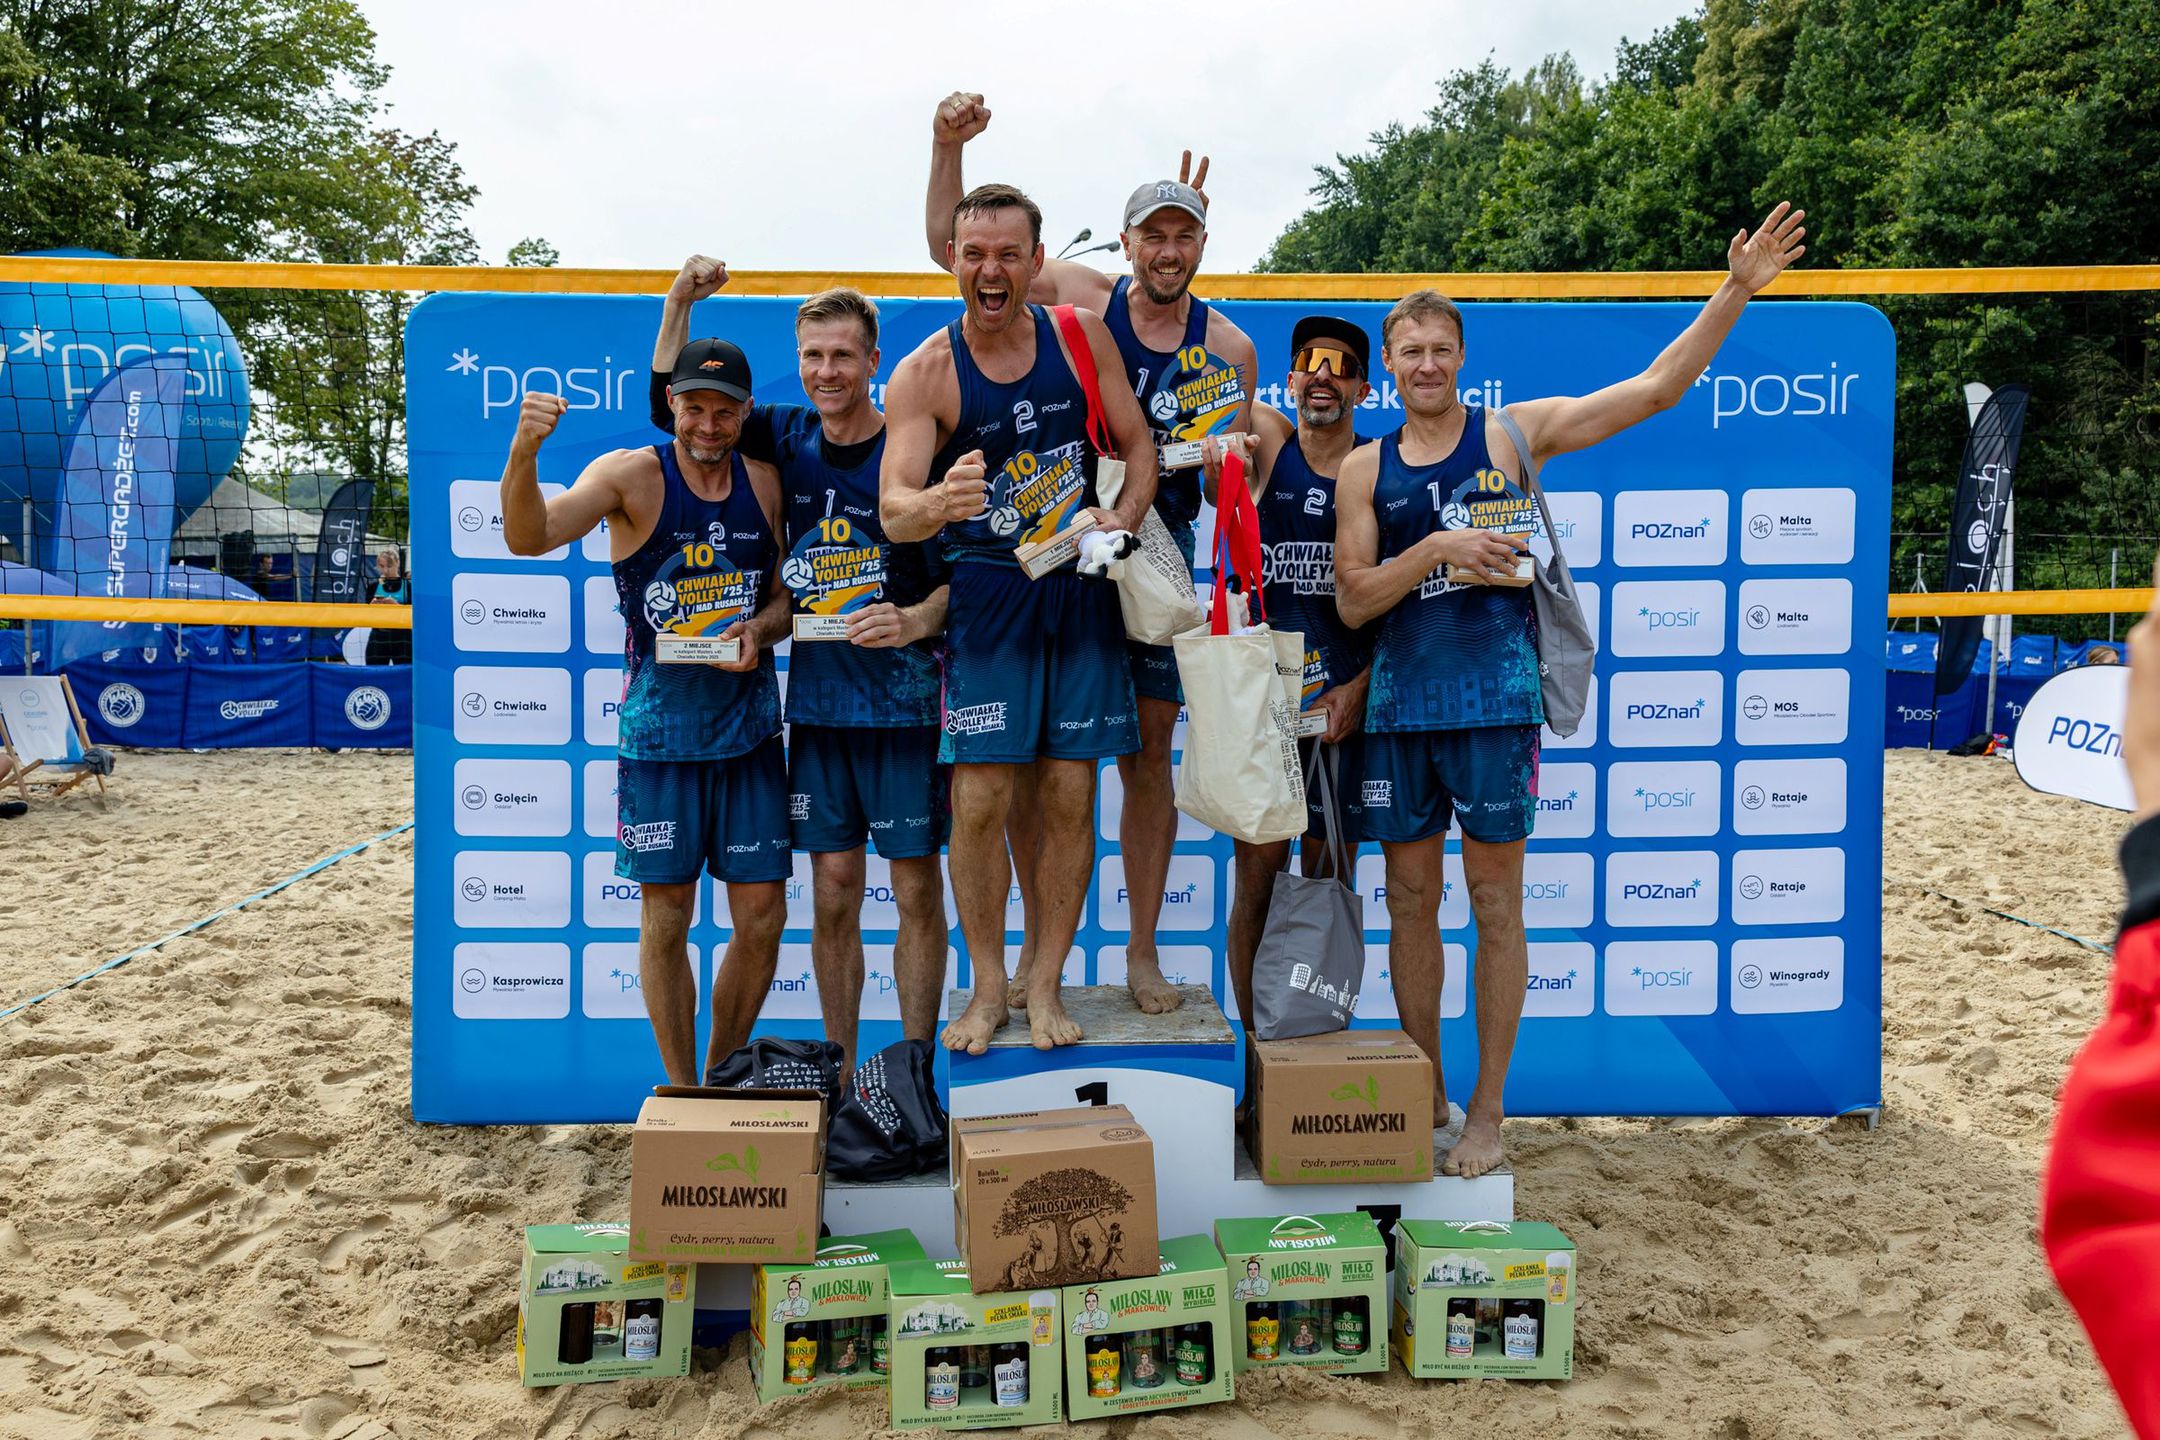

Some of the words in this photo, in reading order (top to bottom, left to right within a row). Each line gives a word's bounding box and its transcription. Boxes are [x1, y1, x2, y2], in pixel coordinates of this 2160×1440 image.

[1178, 346, 1207, 372] 10
[1135, 367, 1150, 398] 1
[1177, 366, 1238, 399] CHWIAŁKA
[1197, 403, 1213, 416] NAD
[1214, 390, 1246, 409] RUSAŁKĄ
[1013, 400, 1038, 434] 2
[1005, 452, 1037, 484] 10
[1014, 456, 1073, 511] CHWIAŁKA
[1475, 469, 1506, 492] 10
[825, 488, 836, 517] 1
[1040, 500, 1055, 516] NAD
[1056, 477, 1087, 502] RUSAŁKĄ
[1304, 487, 1327, 516] 2
[1427, 481, 1441, 511] 1
[1470, 498, 1533, 516] CHWIAŁKA
[1780, 515, 1812, 525] Malta
[708, 521, 727, 551] 2
[819, 518, 851, 542] 10
[683, 544, 714, 568] 10
[812, 546, 881, 570] CHWIAŁKA
[675, 570, 744, 593] CHWIAŁKA
[833, 580, 850, 590] NAD
[852, 572, 888, 586] RUSAŁKĄ
[1423, 581, 1445, 595] NAD
[696, 604, 713, 613] NAD
[715, 595, 749, 610] RUSAŁKĄ
[493, 608, 546, 619] Chwiałka
[1777, 612, 1808, 622] Malta
[494, 701, 547, 711] Chwiałka
[957, 703, 1001, 720] CHWIAŁKA
[1774, 702, 1799, 712] MOS
[494, 793, 538, 805] Golęcin
[1772, 792, 1808, 803] Rataje
[494, 885, 524, 895] Hotel
[1770, 881, 1806, 893] Rataje
[493, 976, 564, 987] Kasprowicza
[1769, 969, 1830, 982] Winogrady
[729, 1120, 809, 1128] MIŁOSŁAWSKI
[1291, 1113, 1406, 1135] MIŁOSŁAWSKI
[1301, 1158, 1327, 1168] Cydr,
[1330, 1158, 1360, 1168] perry,
[1363, 1158, 1396, 1166] natura
[661, 1185, 787, 1209] MIŁOSŁAWSKI
[1026, 1197, 1100, 1217] MIŁOSŁAWSKI
[574, 1224, 630, 1232] MIŁOSŁA
[670, 1233, 699, 1245] Cydr,
[701, 1236, 735, 1245] perry,
[738, 1236, 775, 1245] natura
[1268, 1234, 1337, 1249] MIŁOSŁAW
[1271, 1261, 1332, 1284] MIŁOSŁAW
[1342, 1262, 1374, 1274] MIŁO
[1284, 1275, 1326, 1285] MAKŁOWICZ
[811, 1279, 874, 1303] MIŁOSŁAW
[825, 1295, 867, 1304] MAKŁOWICZ
[1183, 1286, 1215, 1300] MIŁO
[1110, 1287, 1172, 1315] MIŁOSŁAW
[1124, 1304, 1167, 1317] MAKŁOWICZ
